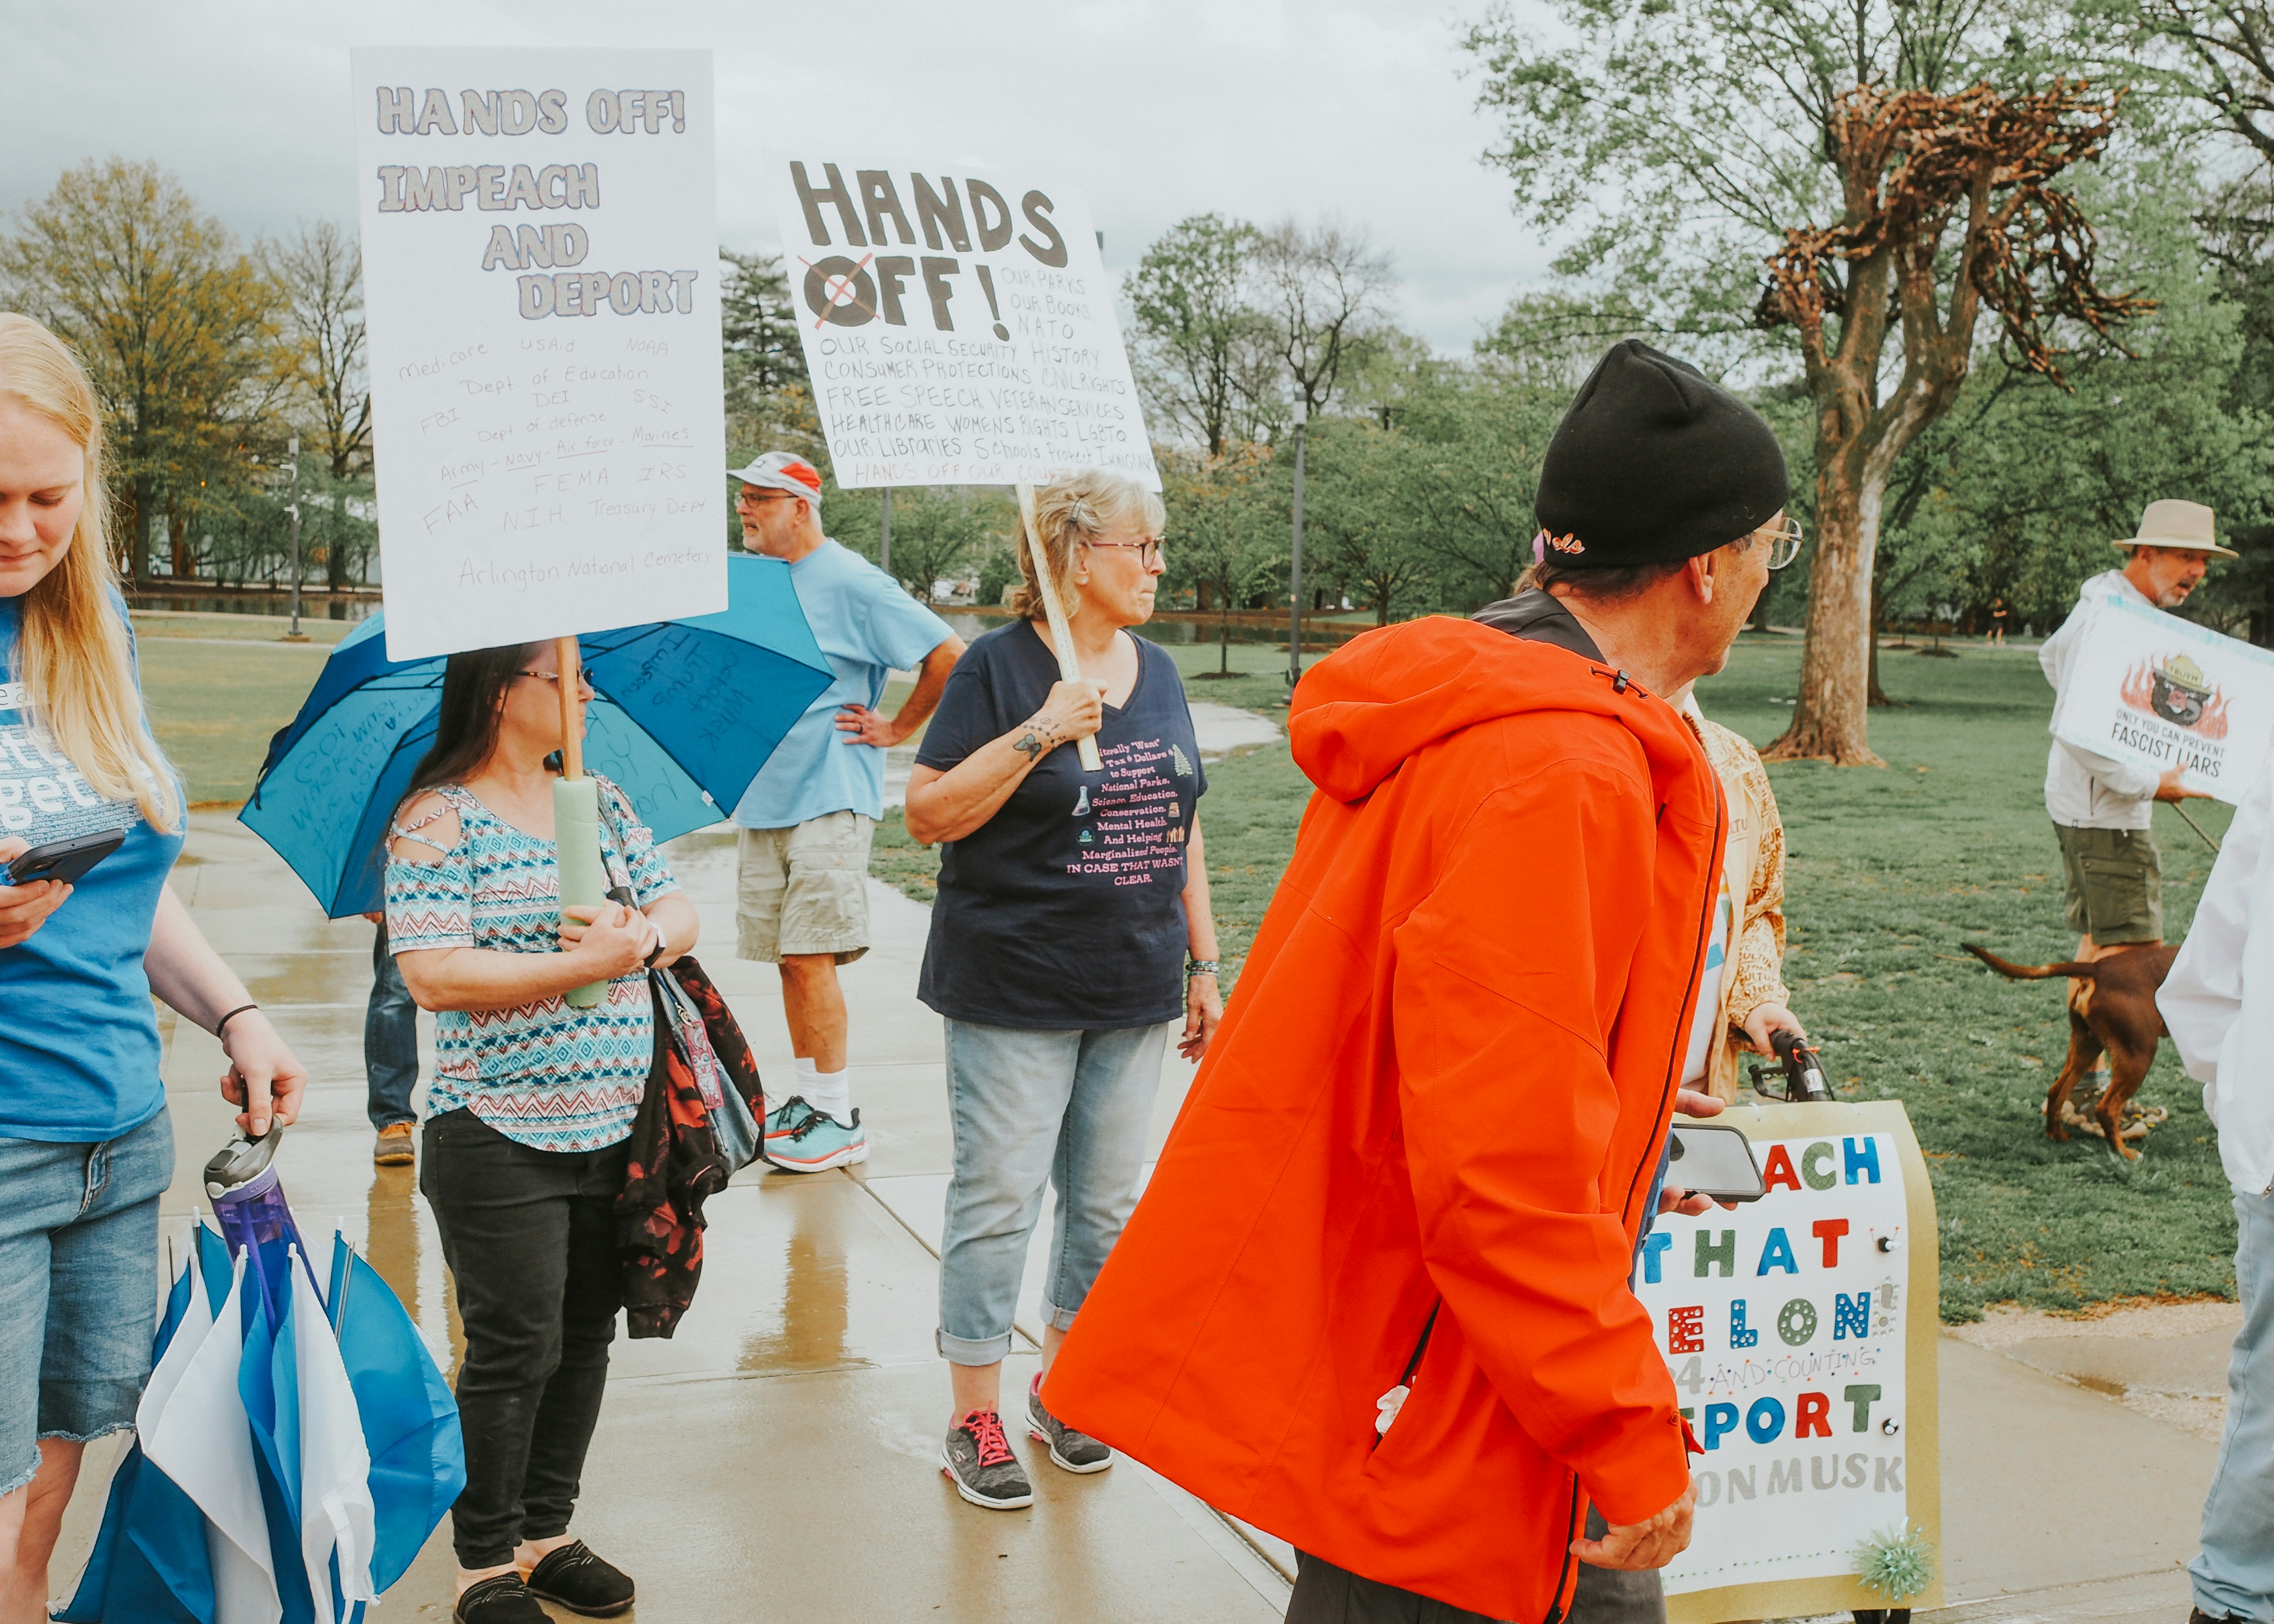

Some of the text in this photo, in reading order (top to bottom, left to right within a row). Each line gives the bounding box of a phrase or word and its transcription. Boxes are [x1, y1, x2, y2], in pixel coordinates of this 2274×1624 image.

[376, 86, 685, 135] HANDS OFF!
[378, 163, 600, 213] IMPEACH
[789, 161, 1068, 268] HANDS
[482, 223, 588, 270] AND
[1001, 267, 1085, 294] OUR PARKS
[517, 270, 698, 320] DEPORT
[804, 255, 1010, 342] OFF!
[1011, 294, 1091, 319] OUR BOOKS
[1019, 315, 1073, 339] NATO
[399, 343, 489, 381] Medicare
[625, 338, 669, 355] NOAA
[820, 337, 869, 356] OUR
[948, 340, 1016, 362] SECURITY
[1031, 340, 1100, 370] HISTORY
[532, 368, 550, 385] of
[564, 366, 648, 382] Education
[824, 360, 917, 380] CONSUMER
[923, 360, 1031, 384] PROTECTIONS
[827, 386, 890, 409] FREE
[900, 384, 982, 408] SPEECH
[420, 389, 672, 433] FBI DEI SSI
[526, 419, 541, 433] of
[549, 412, 607, 430] defense
[945, 415, 1014, 434] WOMENS
[1020, 414, 1068, 438] RIGHTS
[558, 441, 576, 454] Air
[632, 428, 689, 442] Marines
[834, 438, 874, 457] OUR
[534, 463, 688, 493] FEMA IRS
[856, 464, 917, 483] HANDS
[928, 464, 961, 478] OFF
[970, 464, 1001, 480] OUR
[588, 499, 656, 517] Treasury
[459, 546, 712, 592] Arlington National Cemetery
[2169, 666, 2199, 683] TRUTH
[2116, 708, 2225, 757] ONLY YOU CAN PREVENT
[1099, 744, 1130, 757] iterally
[1106, 751, 1168, 767] Tax Dollars
[2111, 723, 2222, 778] FASCIST LIARS
[1101, 778, 1138, 792] National
[1110, 766, 1156, 778] to Support
[1097, 820, 1132, 831] Mental
[1103, 832, 1163, 845] And Helping
[1067, 864, 1081, 873] IN
[1084, 863, 1119, 873] CASE
[1121, 860, 1150, 871] THAT
[1082, 846, 1149, 861] Marginalized
[1763, 1136, 1880, 1194] ACH
[1641, 1218, 1849, 1284] THAT
[1668, 1351, 1874, 1395] 4 AND COUNTING
[1679, 1385, 1881, 1453] PORT
[1767, 1453, 1903, 1495] MUSK
